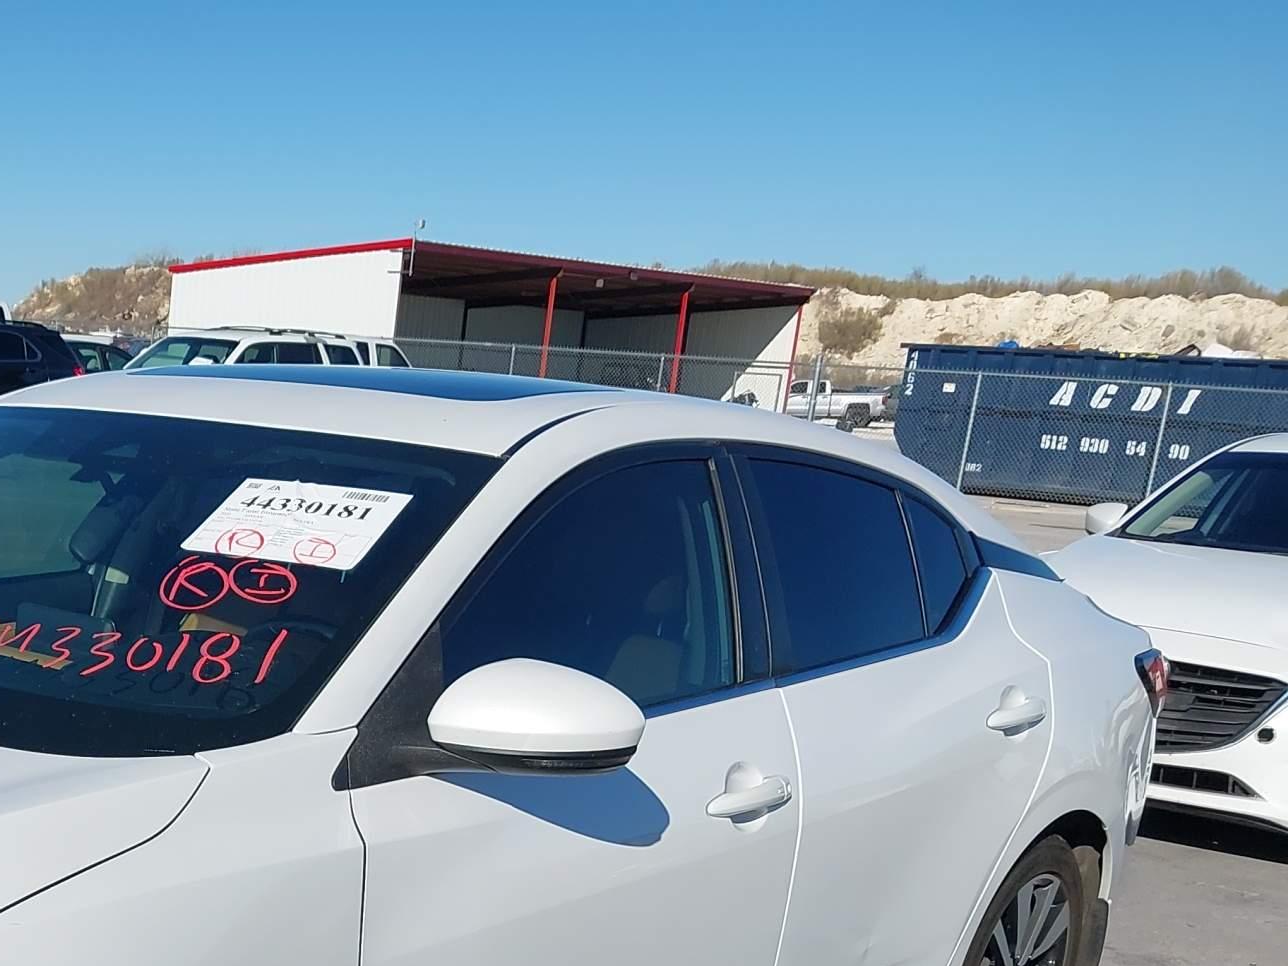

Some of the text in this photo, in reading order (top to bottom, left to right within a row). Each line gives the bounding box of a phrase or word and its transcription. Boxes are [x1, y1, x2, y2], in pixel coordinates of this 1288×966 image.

[1040, 434, 1190, 460] 512 930 54 90
[240, 495, 373, 521] 44330181
